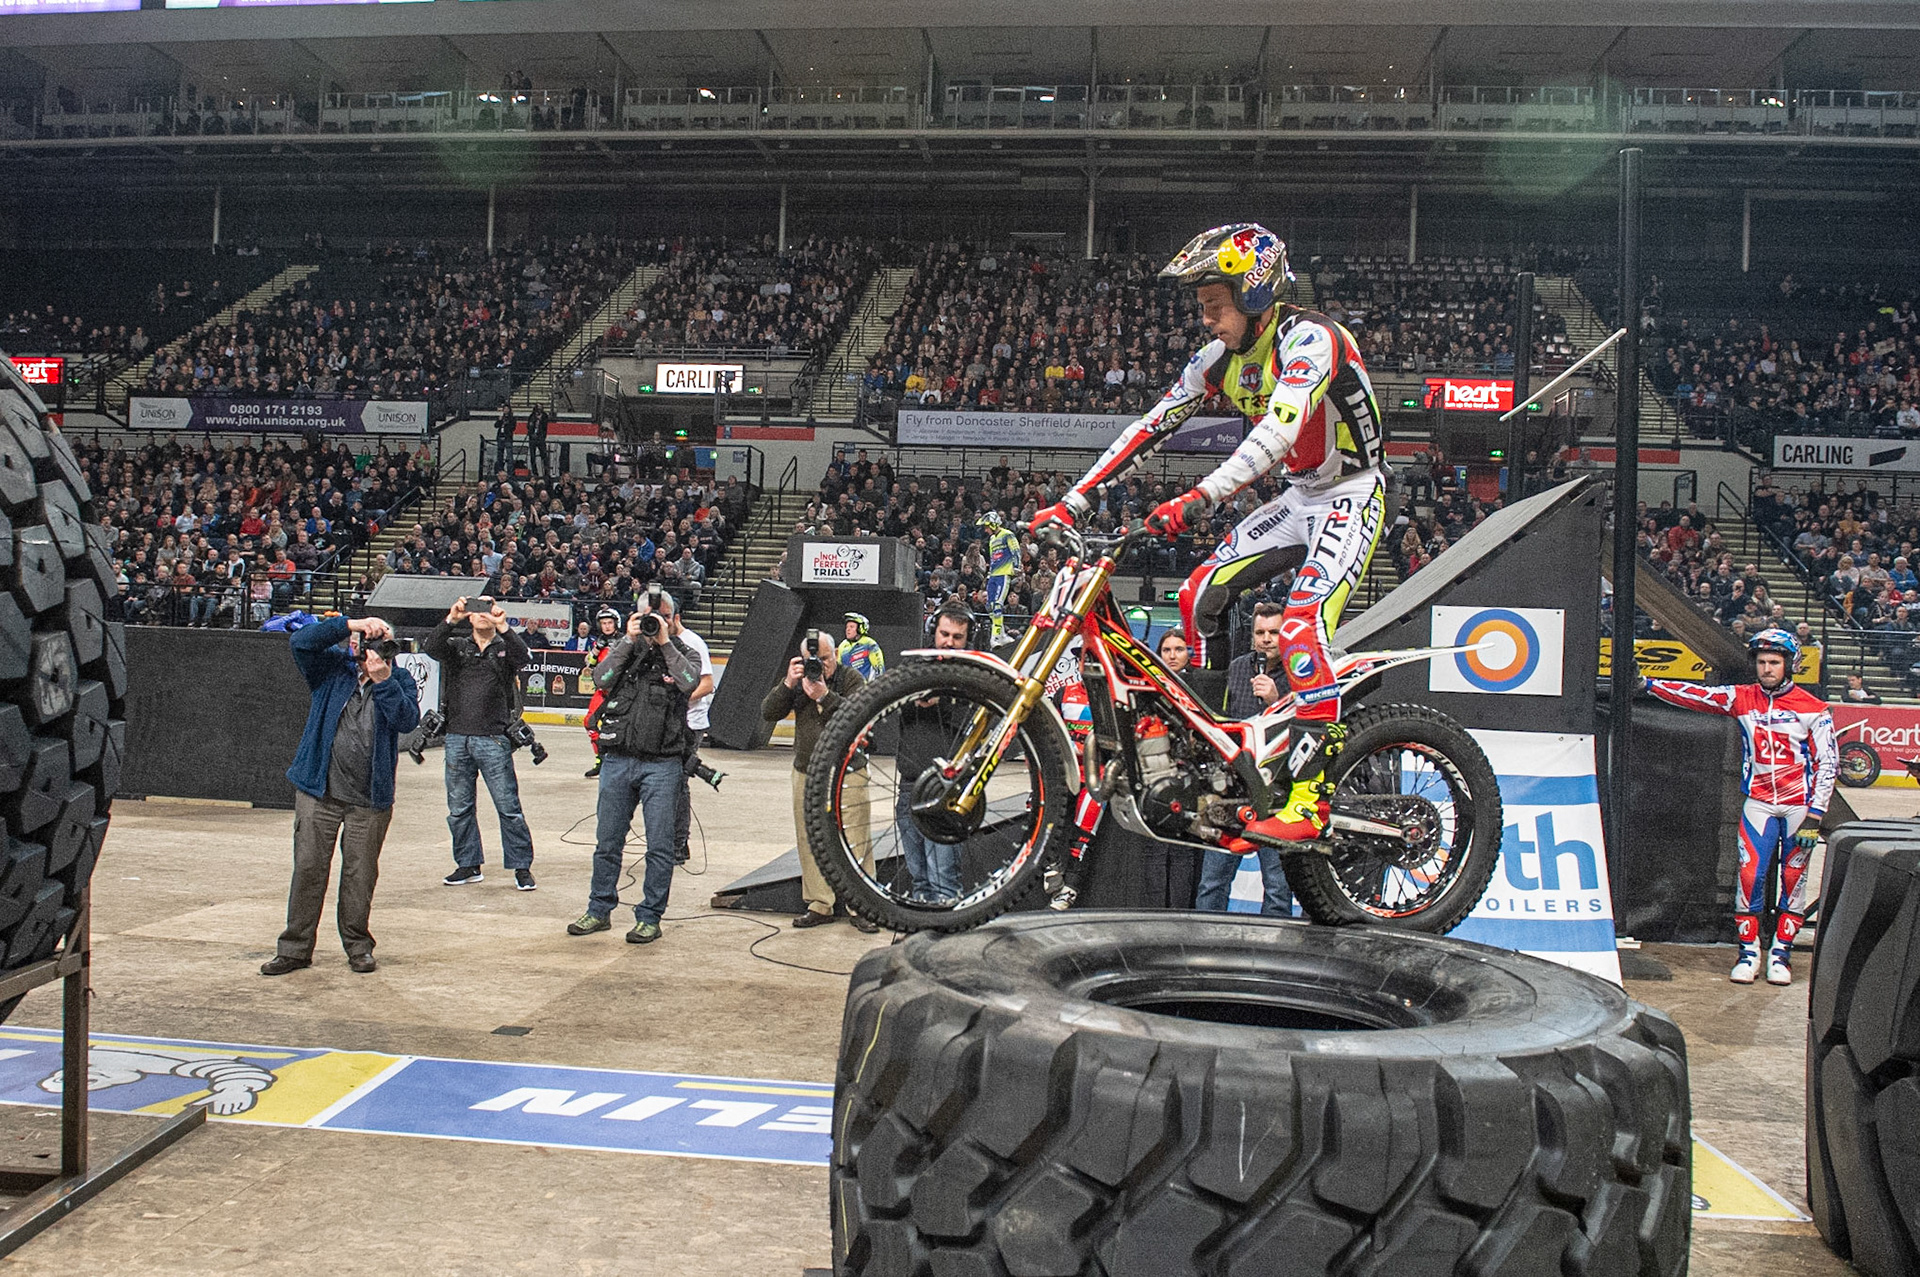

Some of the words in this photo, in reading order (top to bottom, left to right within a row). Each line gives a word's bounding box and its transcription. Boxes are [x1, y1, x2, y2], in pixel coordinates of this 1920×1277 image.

[1245, 252, 1272, 287] Red
[1444, 381, 1499, 402] heart
[140, 409, 176, 418] UNISON
[230, 405, 260, 414] 0800
[266, 405, 286, 414] 171
[291, 406, 322, 415] 2193
[206, 416, 346, 428] www.join.unison.org.uk
[378, 413, 416, 422] UNISON
[906, 415, 921, 427] Fly
[926, 415, 952, 425] from
[956, 416, 1015, 427] Doncaster
[1019, 417, 1071, 428] Sheffield
[1074, 418, 1116, 431] Airport
[1783, 444, 1853, 464] CARLING
[820, 551, 838, 560] INCH
[813, 558, 848, 569] PERFECT
[813, 568, 851, 577] TRIALS
[521, 664, 540, 672] ELD
[541, 664, 580, 675] BREWERY
[1761, 740, 1787, 758] 22
[1500, 812, 1599, 891] th
[1486, 899, 1602, 913] OILERS
[468, 1087, 832, 1134] ELIN
